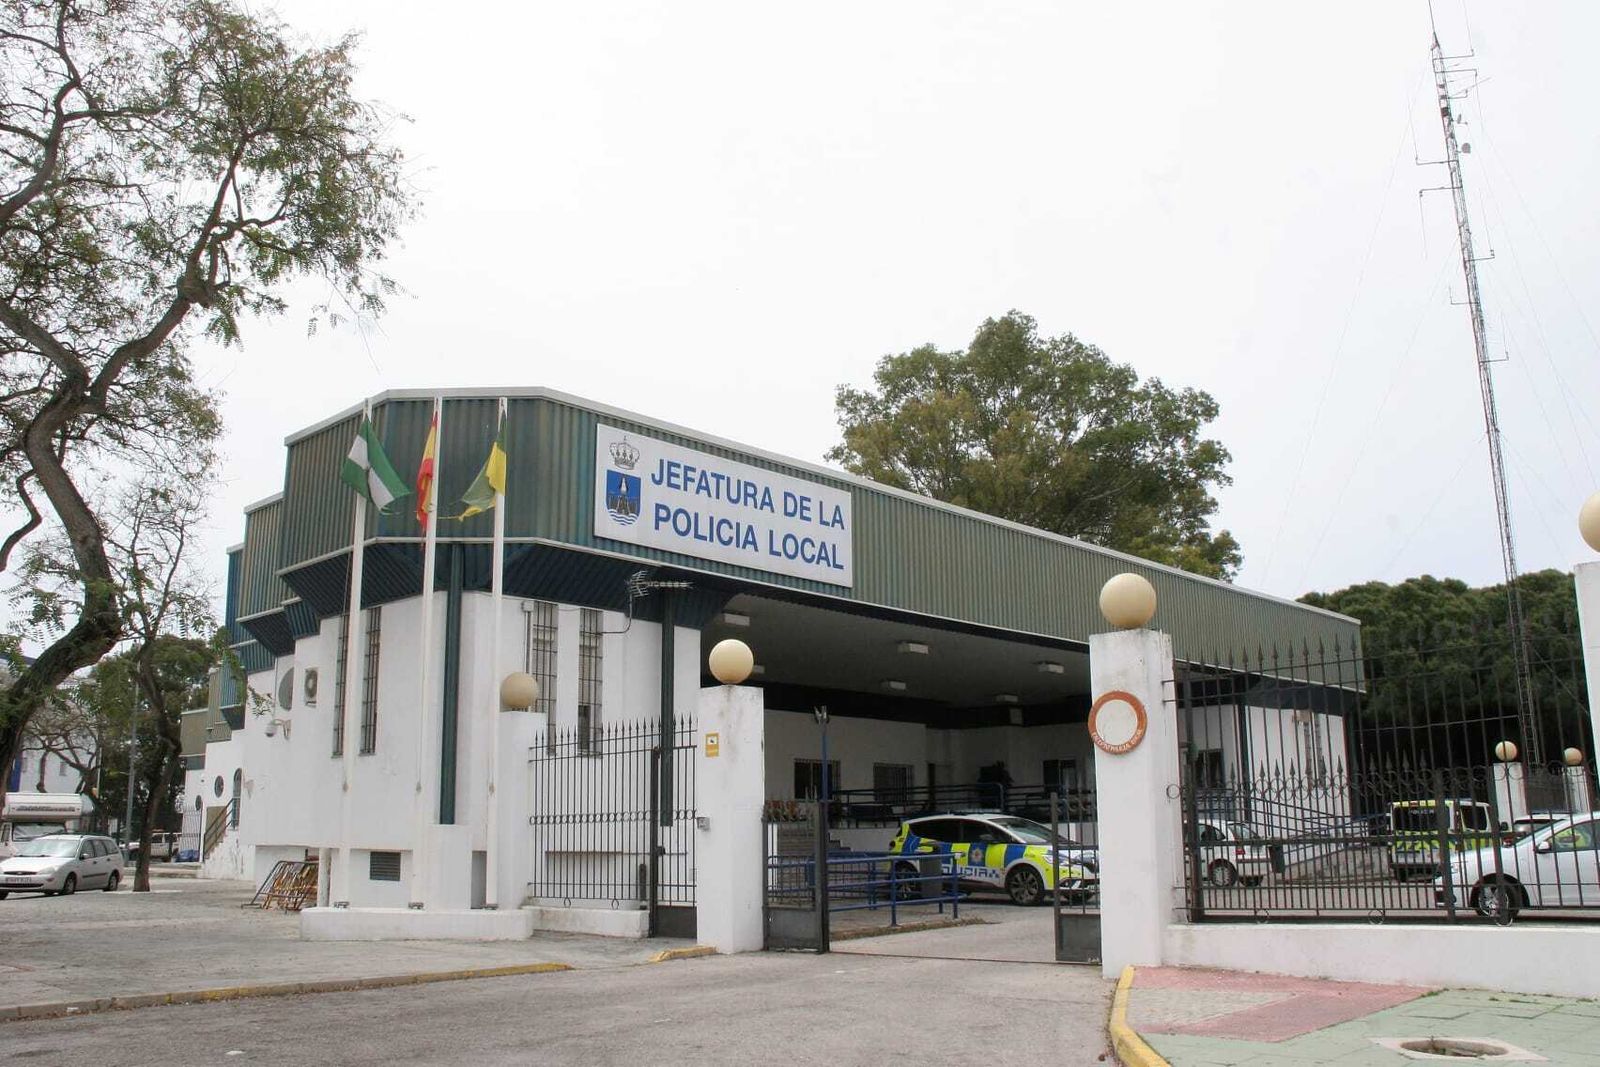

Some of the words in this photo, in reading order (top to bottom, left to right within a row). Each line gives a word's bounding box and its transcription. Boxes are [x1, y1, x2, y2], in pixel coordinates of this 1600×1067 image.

[651, 458, 775, 513] JEFATURA
[782, 491, 812, 522] DE
[818, 500, 845, 530] LA
[654, 502, 759, 552] POLICIA
[768, 529, 844, 570] LOCAL
